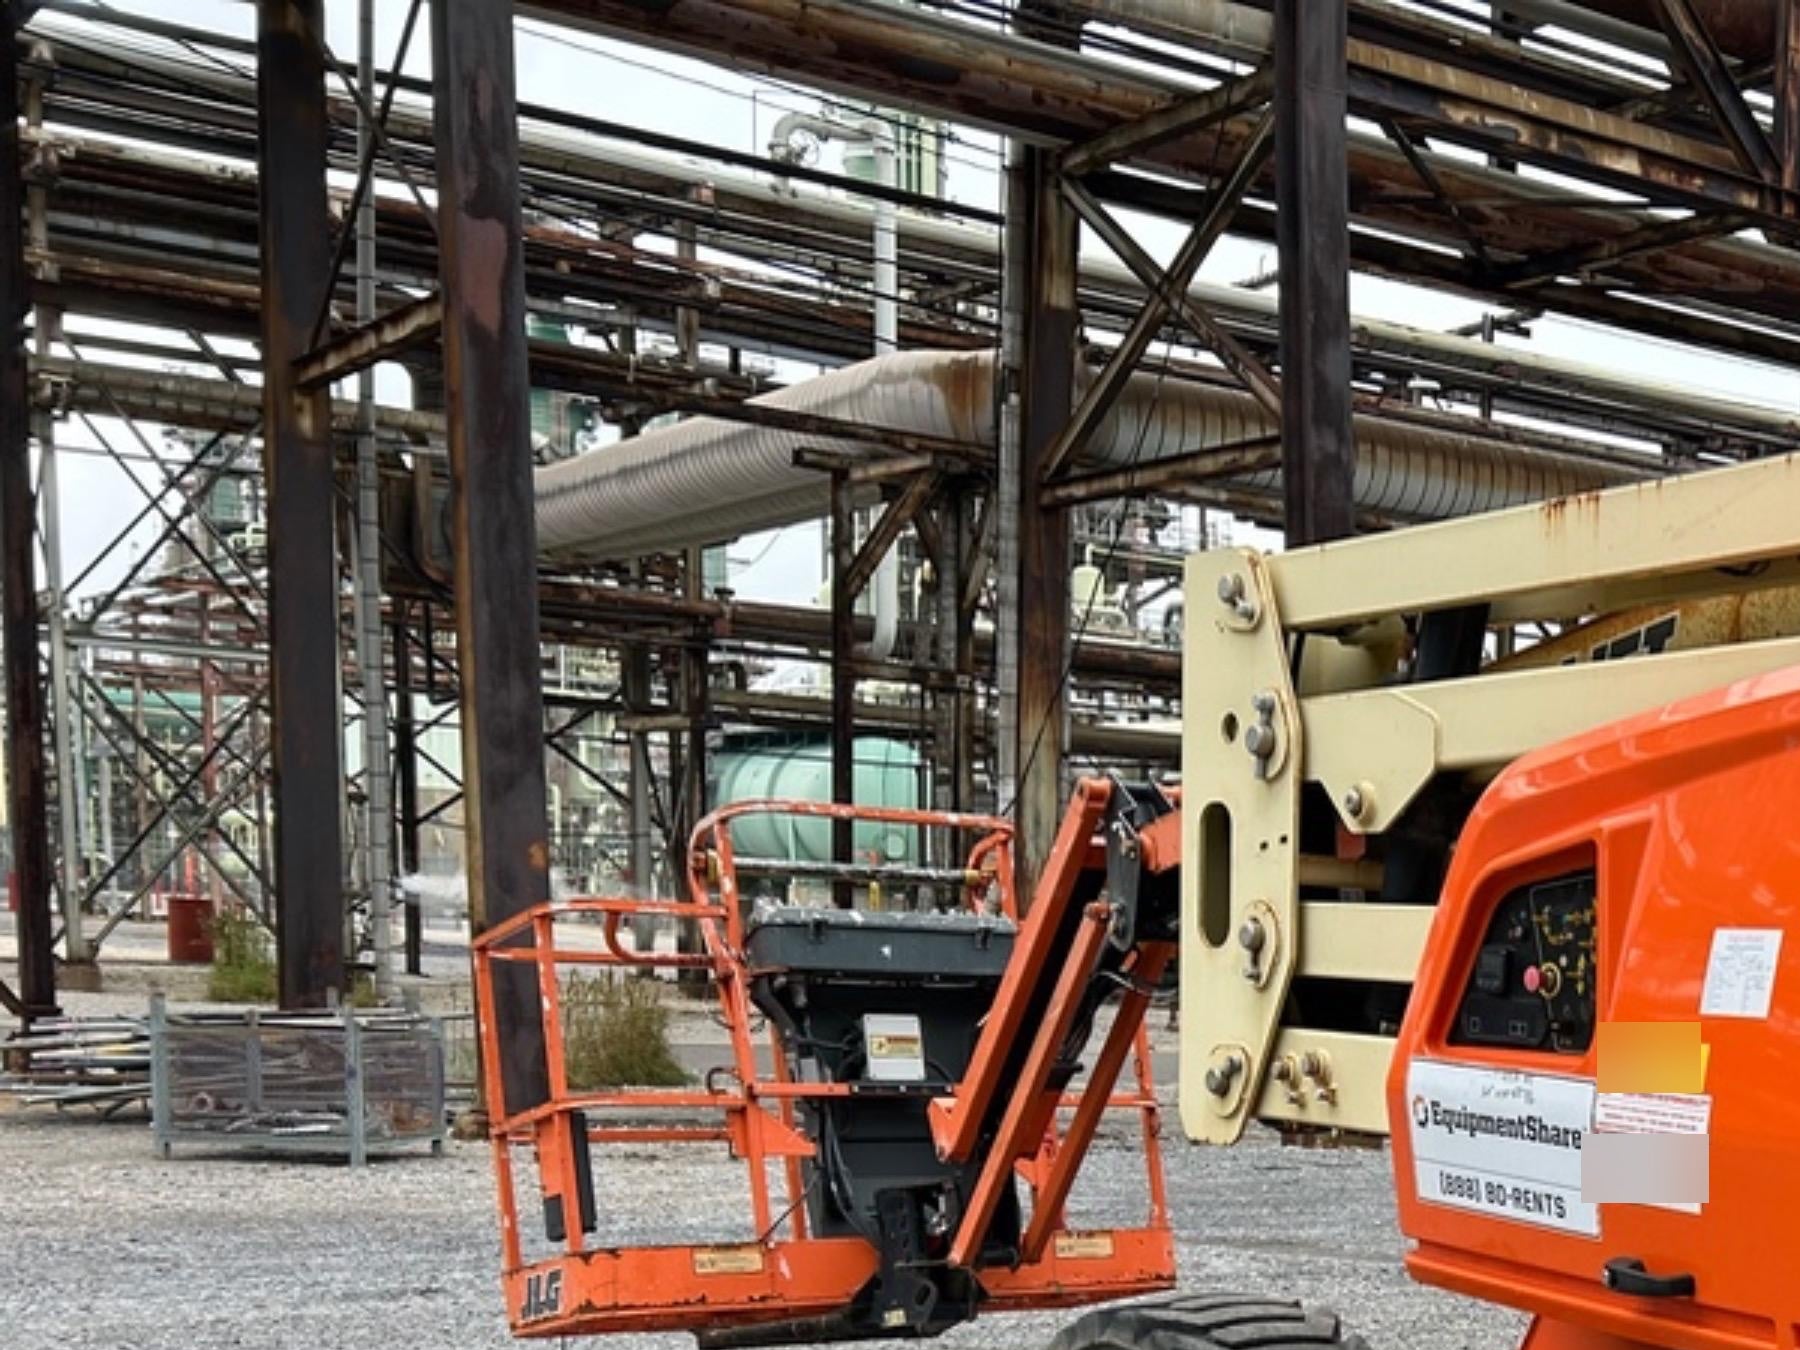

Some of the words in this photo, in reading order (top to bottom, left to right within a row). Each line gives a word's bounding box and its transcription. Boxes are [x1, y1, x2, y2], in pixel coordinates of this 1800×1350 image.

[1430, 1100, 1582, 1150] EquipmentShare
[1439, 1170, 1480, 1203] (888)
[1484, 1180, 1567, 1219] 80-RENTS
[522, 1268, 563, 1320] JLG
